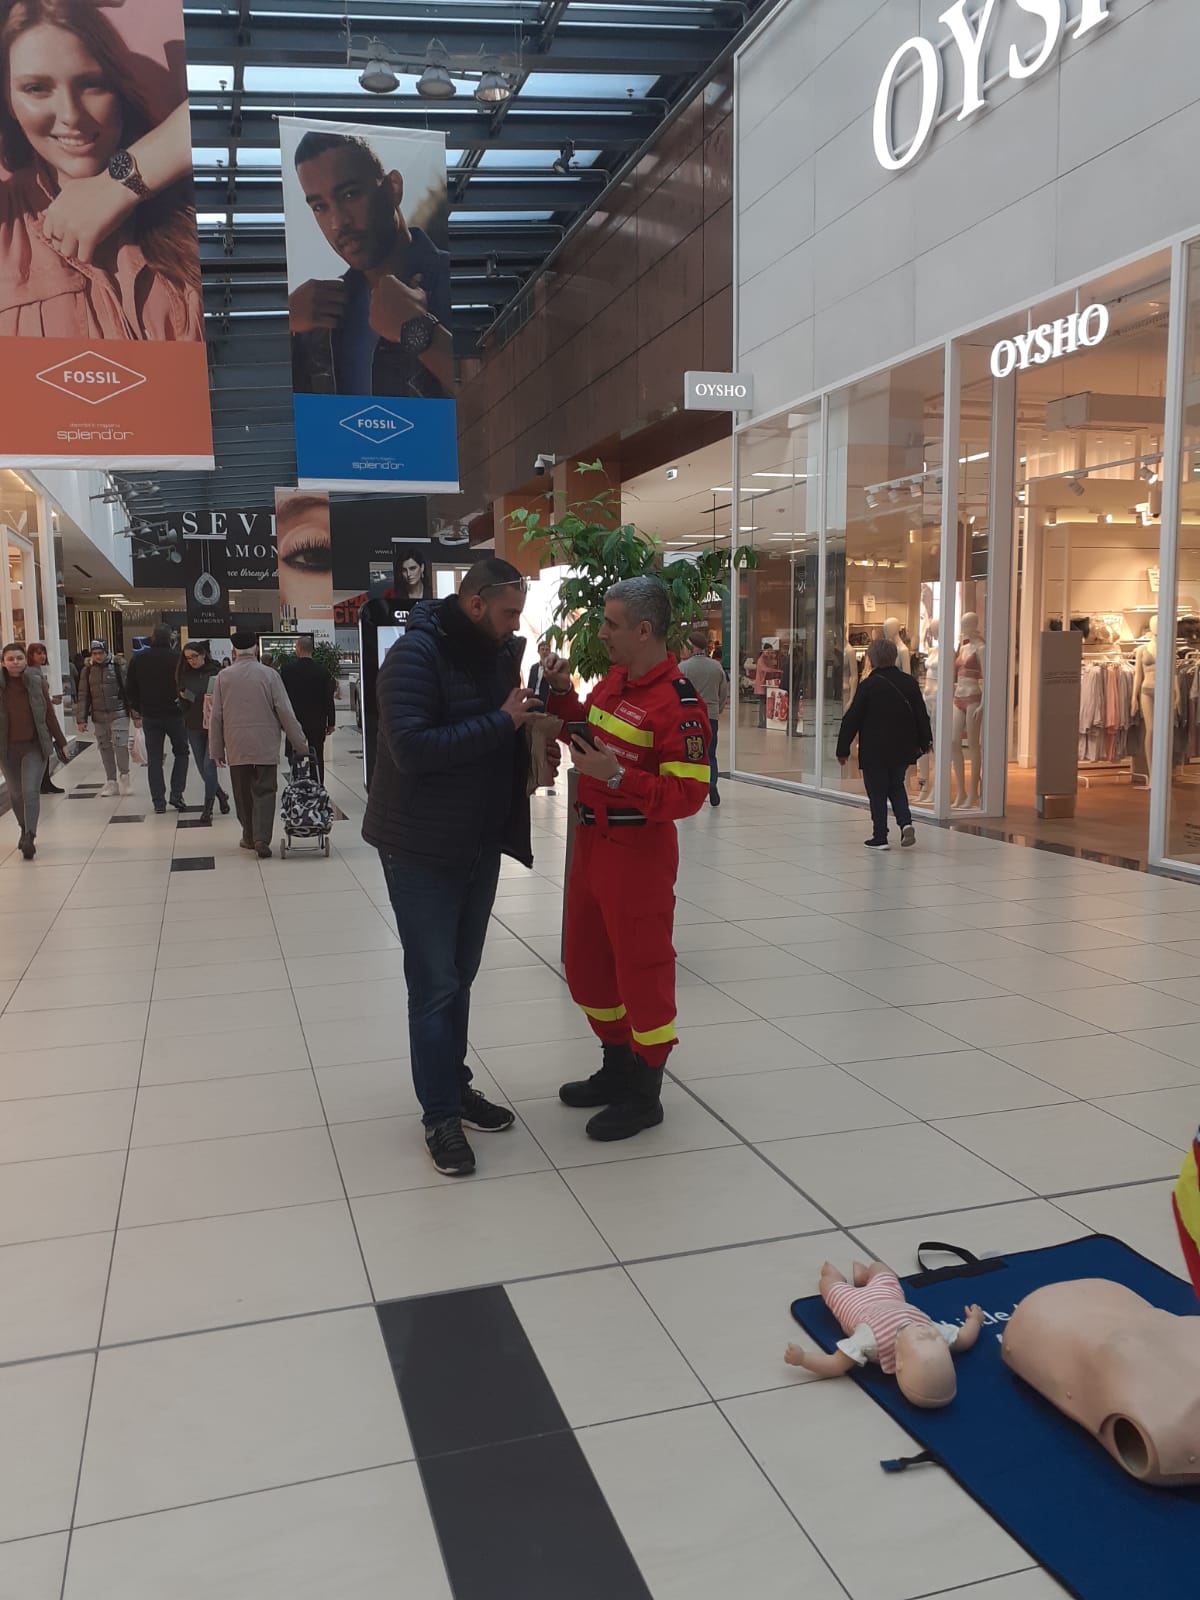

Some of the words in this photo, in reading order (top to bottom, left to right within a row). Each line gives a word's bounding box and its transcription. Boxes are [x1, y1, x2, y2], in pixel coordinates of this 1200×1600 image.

[990, 303, 1109, 378] OYSHO
[63, 370, 121, 384] FOSSIL
[695, 383, 747, 398] OYSHO
[357, 419, 397, 430] FOSSIL
